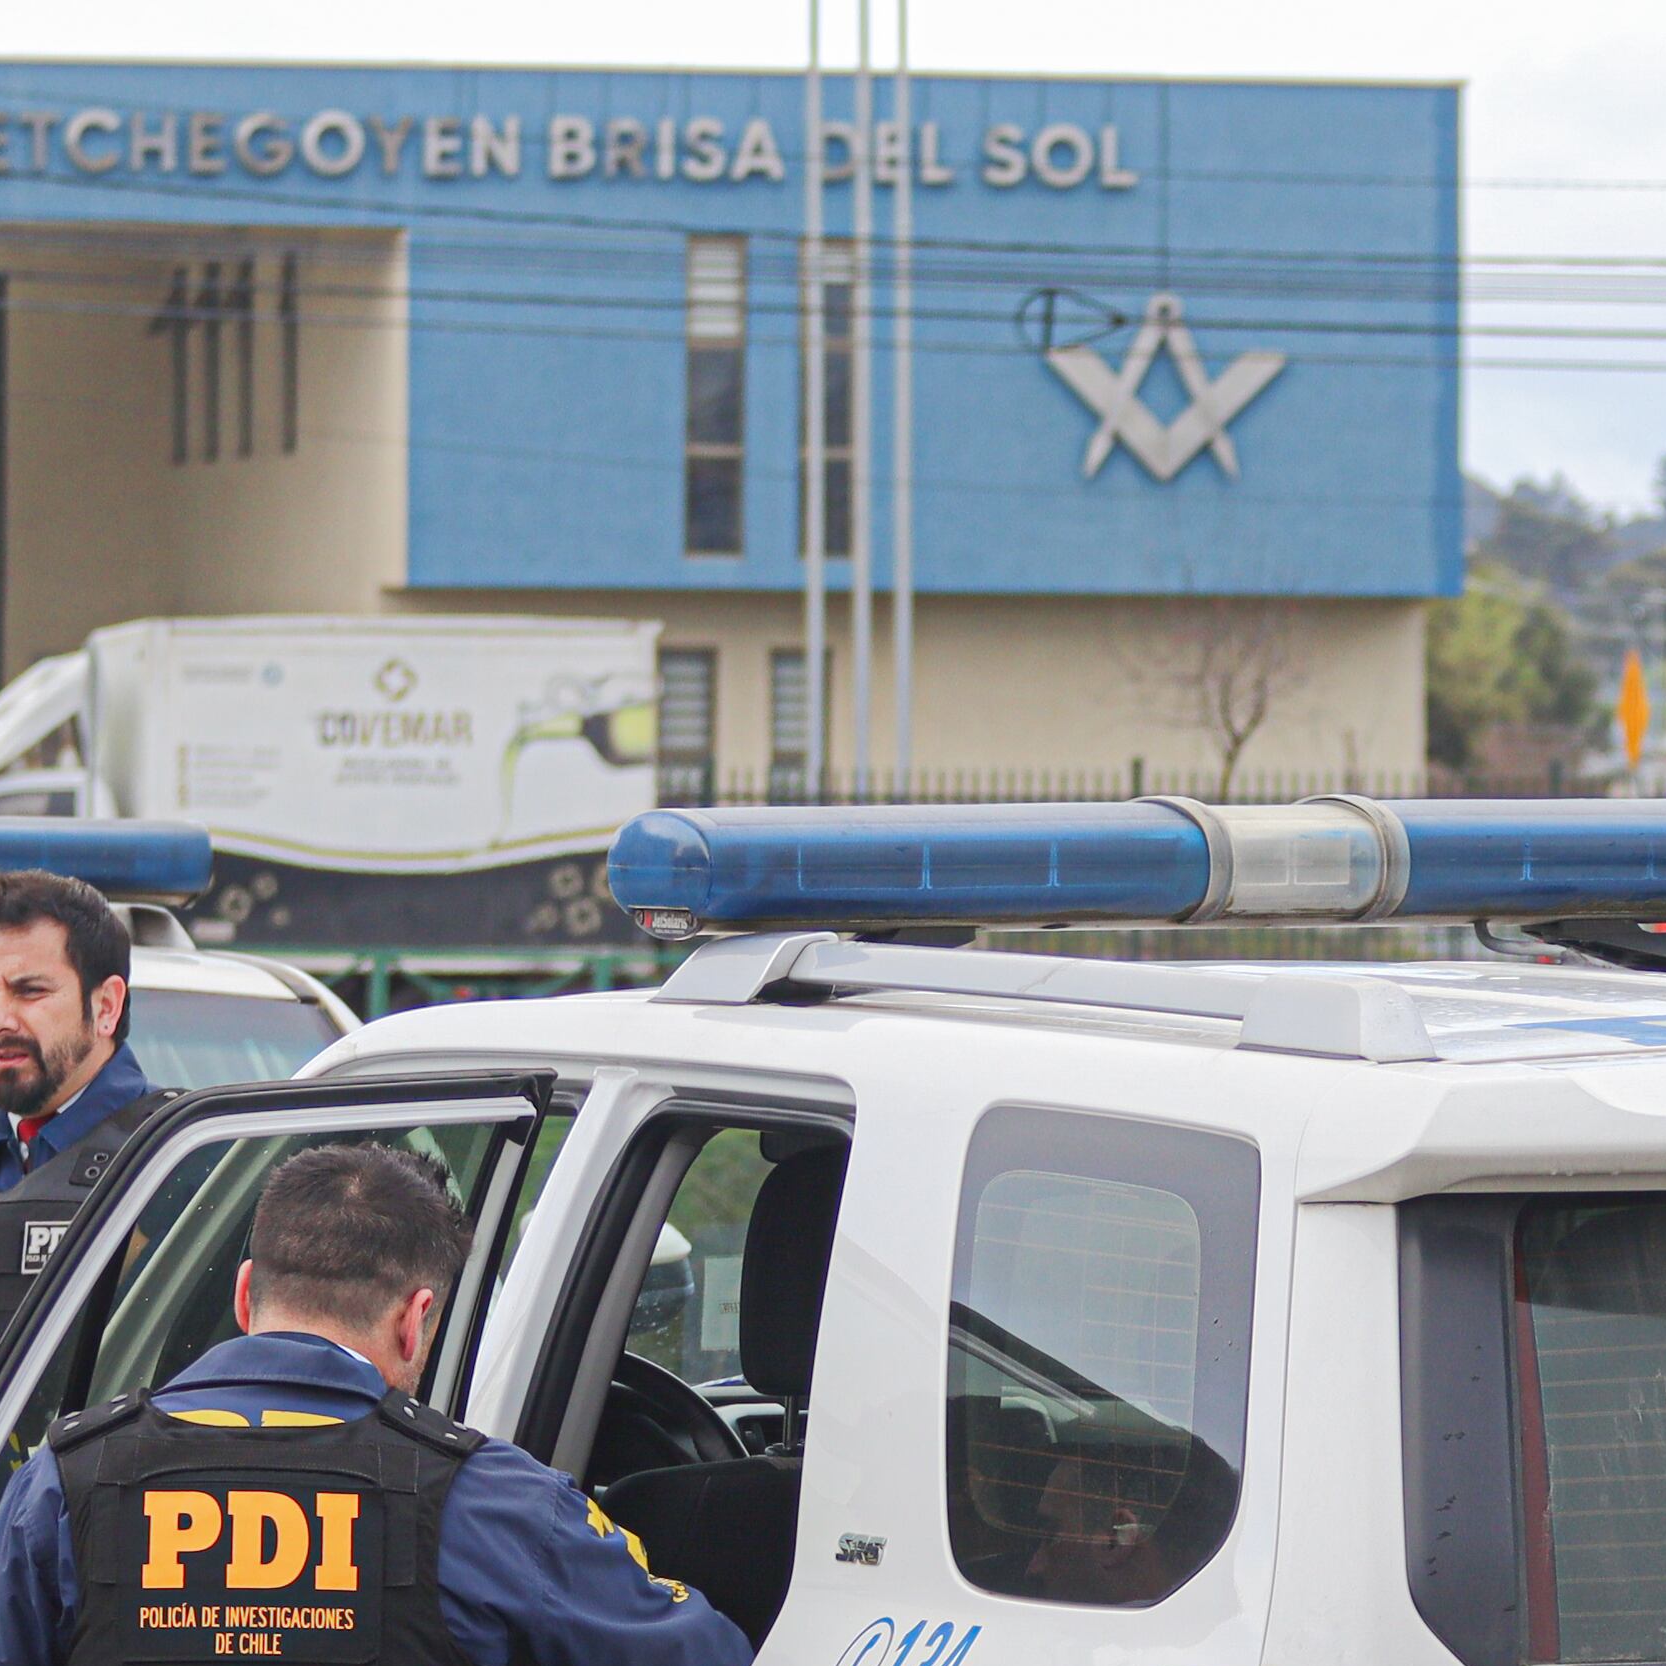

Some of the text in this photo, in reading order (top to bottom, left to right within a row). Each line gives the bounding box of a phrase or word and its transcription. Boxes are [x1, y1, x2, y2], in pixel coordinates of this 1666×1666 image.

[547, 114, 785, 183] BRISA
[820, 118, 956, 188] DEL
[982, 122, 1139, 190] SOL
[141, 1490, 361, 1592] PDI
[140, 1602, 355, 1630] POLICÍA DE INVESTIGACIONES
[215, 1632, 282, 1656] DE CHILE
